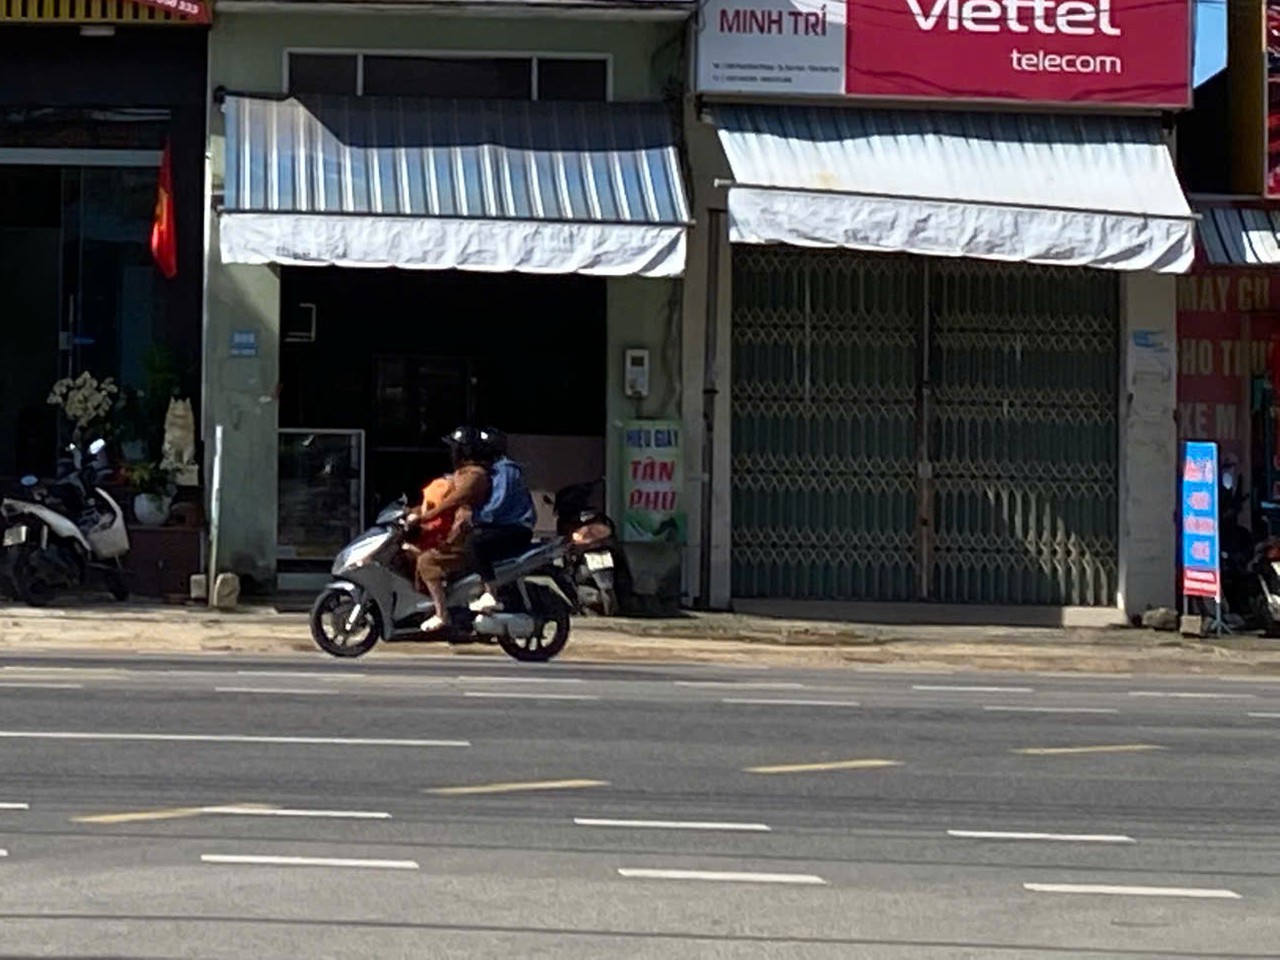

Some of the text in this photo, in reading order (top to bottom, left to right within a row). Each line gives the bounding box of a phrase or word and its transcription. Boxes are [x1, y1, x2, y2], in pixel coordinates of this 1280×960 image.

[720, 3, 827, 37] MINH TRÍ
[1010, 48, 1121, 74] telecom
[630, 455, 675, 481] TÂN
